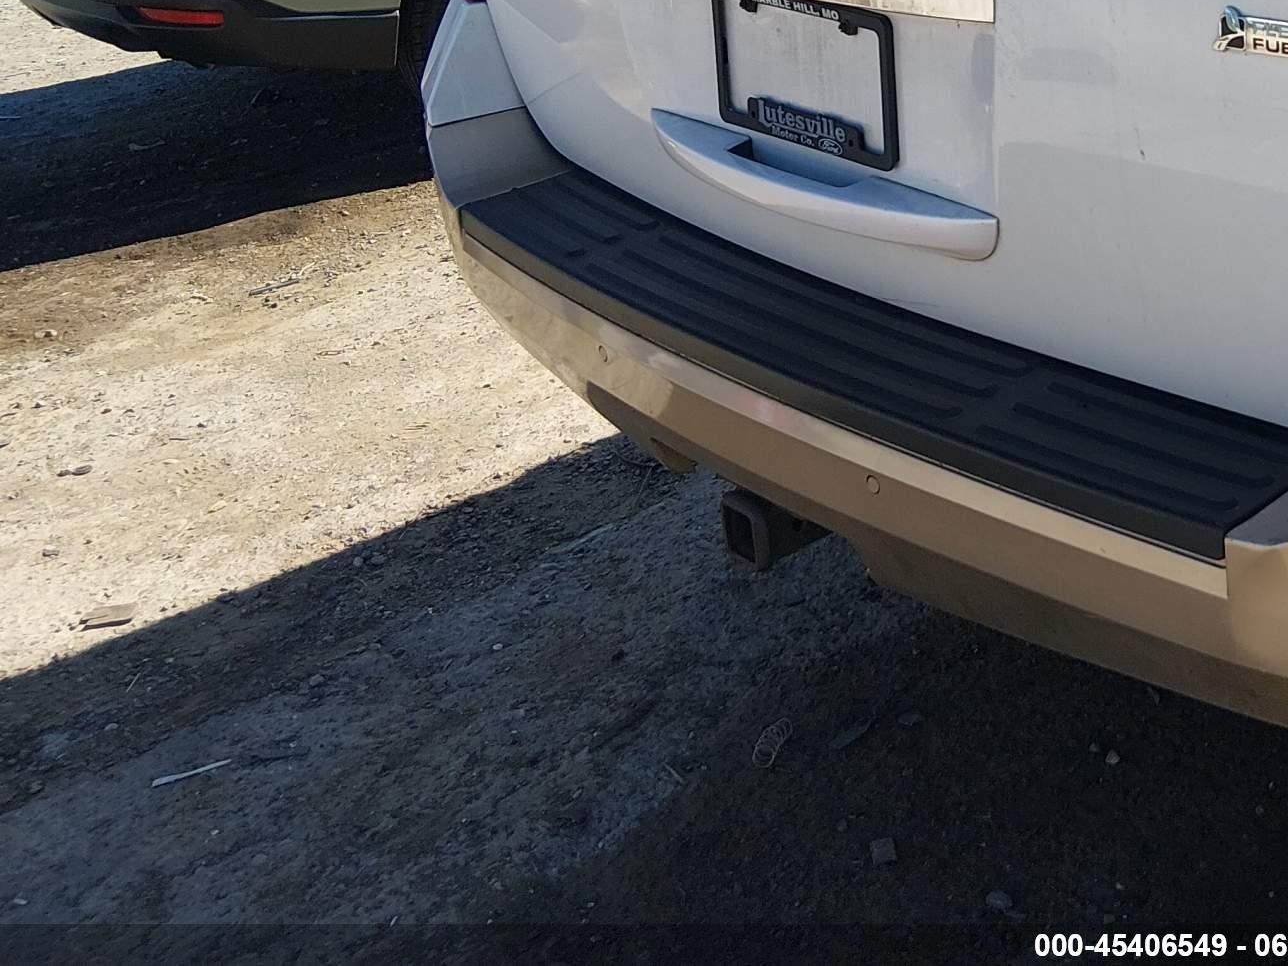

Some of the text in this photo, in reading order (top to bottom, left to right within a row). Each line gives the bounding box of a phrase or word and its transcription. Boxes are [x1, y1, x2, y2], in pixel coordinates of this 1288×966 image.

[821, 8, 840, 20] MO
[757, 99, 847, 143] Lutesville
[771, 126, 815, 147] Motor Co.
